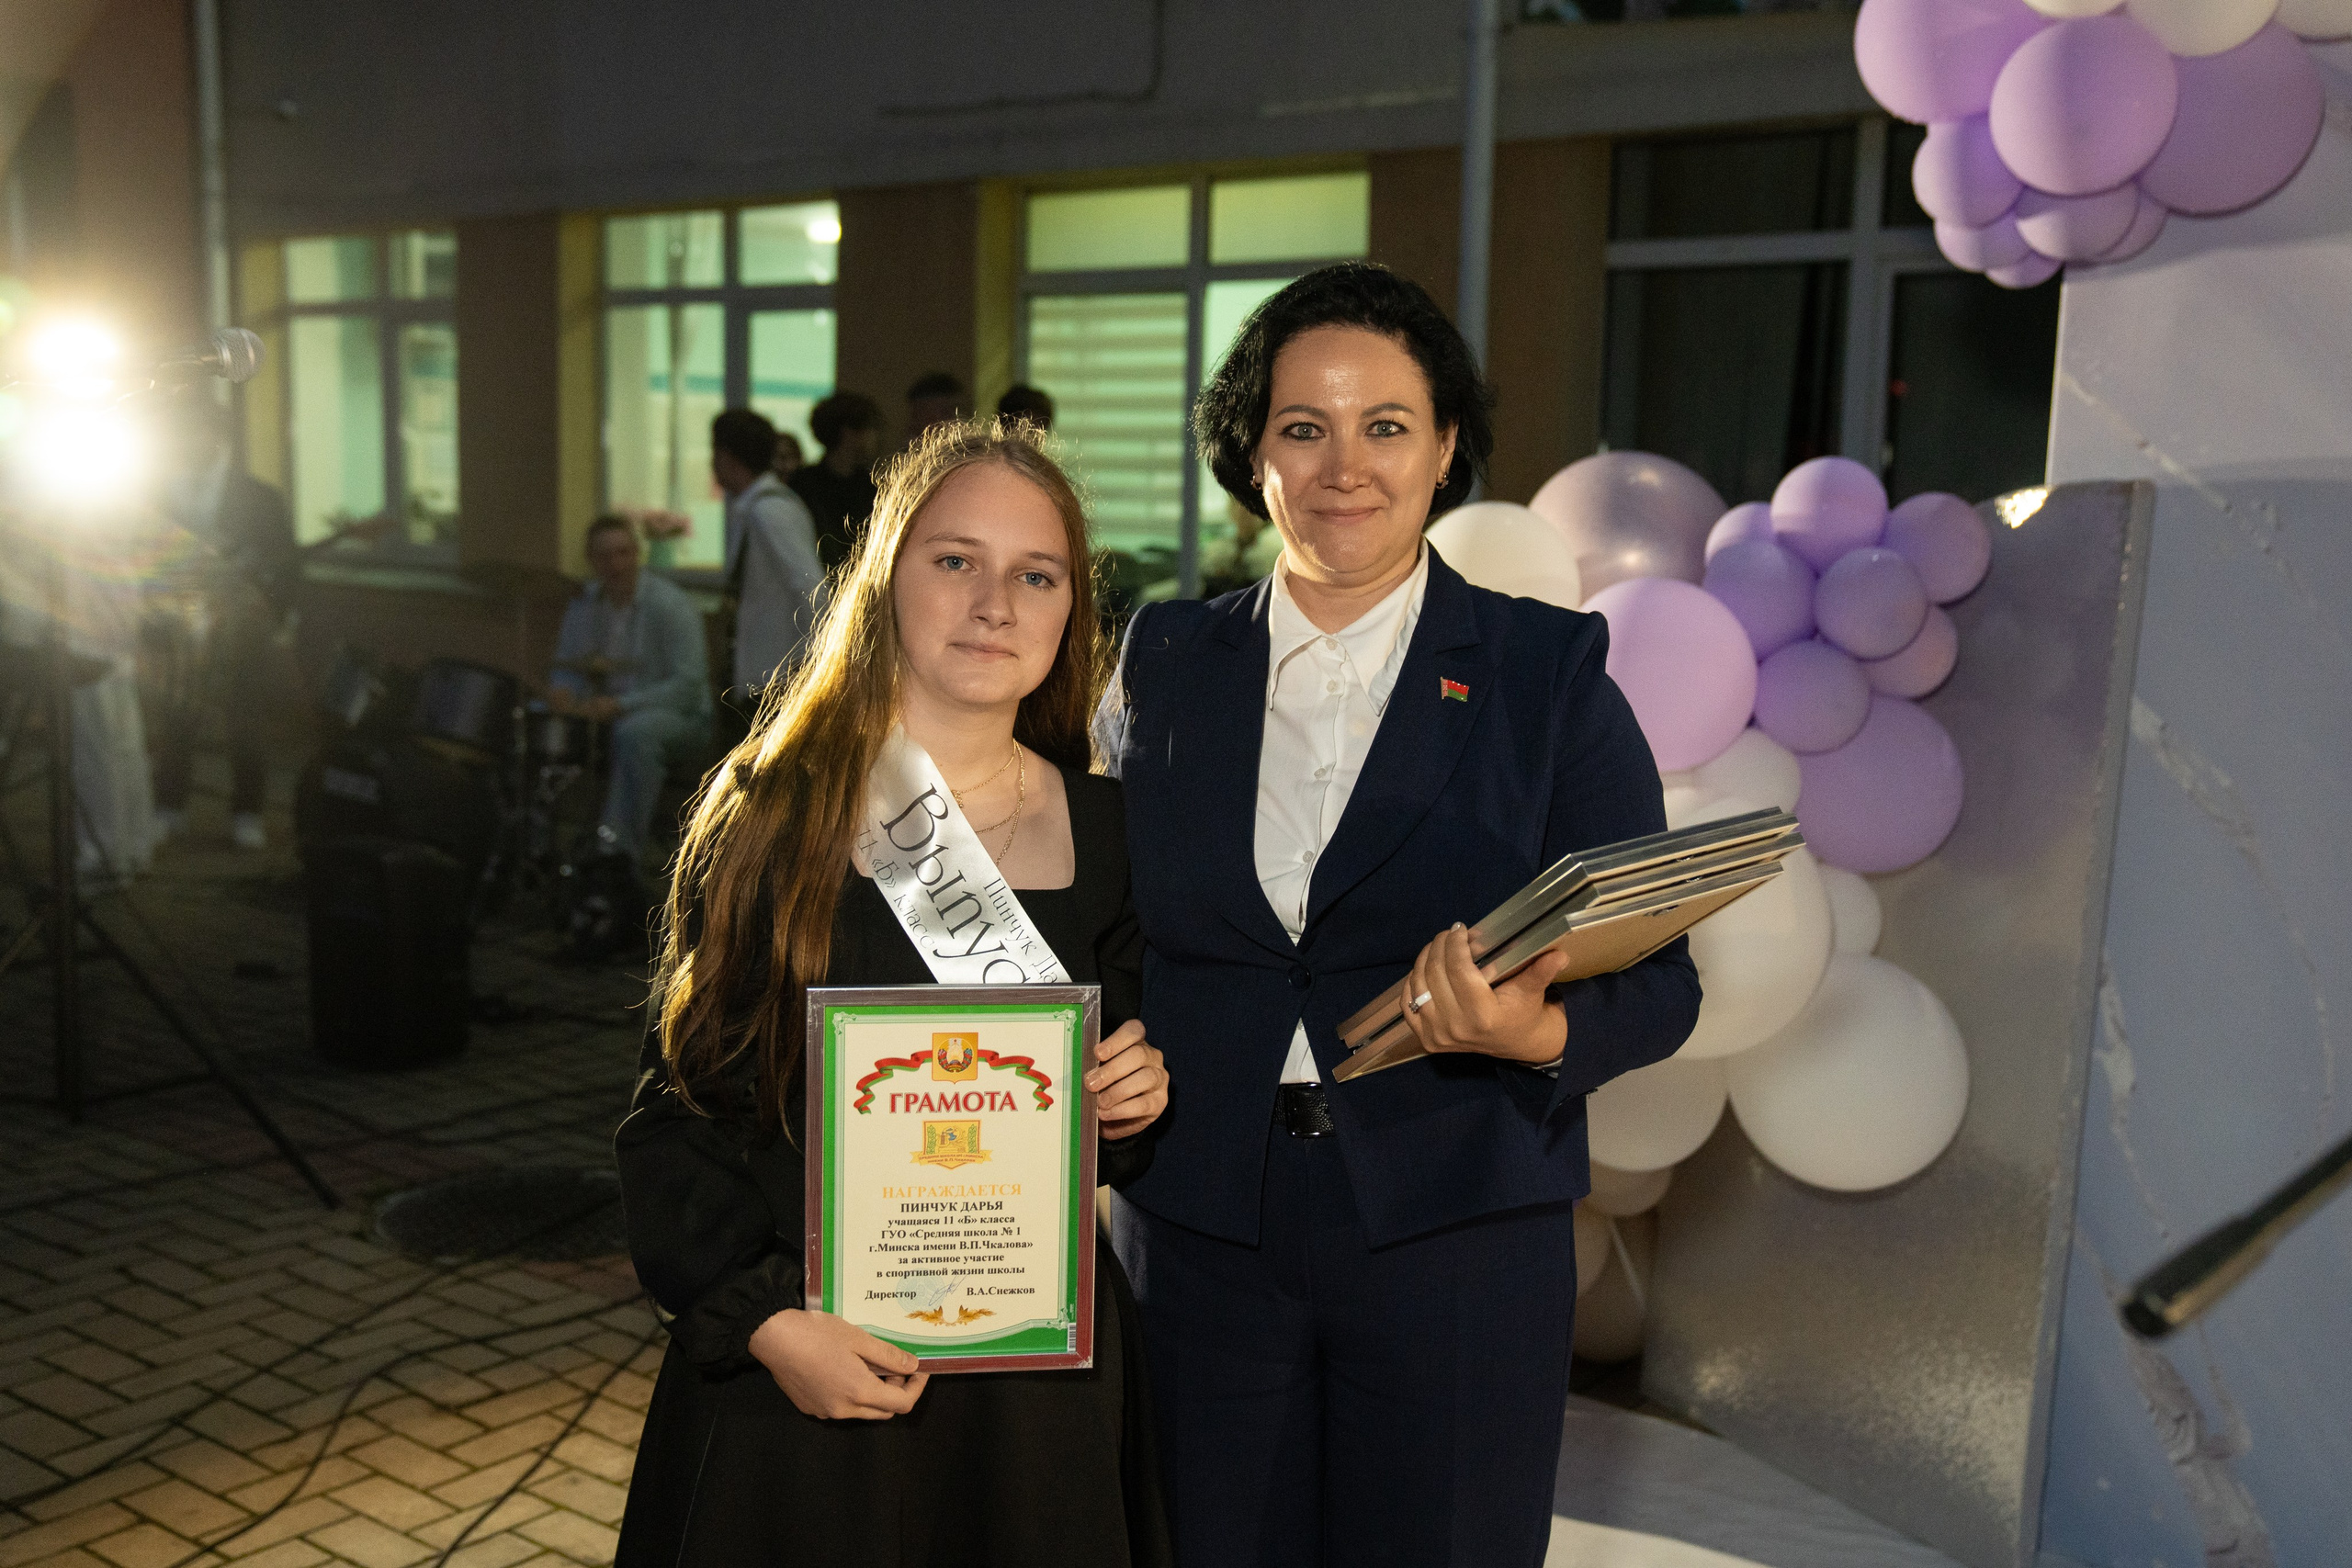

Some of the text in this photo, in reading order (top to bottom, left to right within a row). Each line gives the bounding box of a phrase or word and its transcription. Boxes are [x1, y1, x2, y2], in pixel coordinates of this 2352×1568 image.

[872, 859, 900, 888] «Б»
[894, 894, 935, 949] класс
[983, 877, 1037, 956] Пинчук
[889, 1090, 1019, 1113] ГРАМОТА
[882, 1183, 1023, 1199] НАГРАЖДАЕТСЯ
[900, 1201, 1003, 1213] ПИНЧУК ДАРЬЯ
[888, 1218, 940, 1228] учащаяся
[944, 1216, 954, 1224] 11
[957, 1215, 978, 1224] «Б»
[881, 1226, 1021, 1240] ГУО «Средняя школа № 1
[868, 1240, 1034, 1252] г.Минска имени В.П.Чкалова»
[898, 1254, 1005, 1265] за активное участие
[886, 1267, 948, 1280] спортивной
[951, 1268, 985, 1276] жизни
[987, 1267, 1025, 1275] школы
[865, 1286, 1035, 1302] Директор В.А.Снежков
